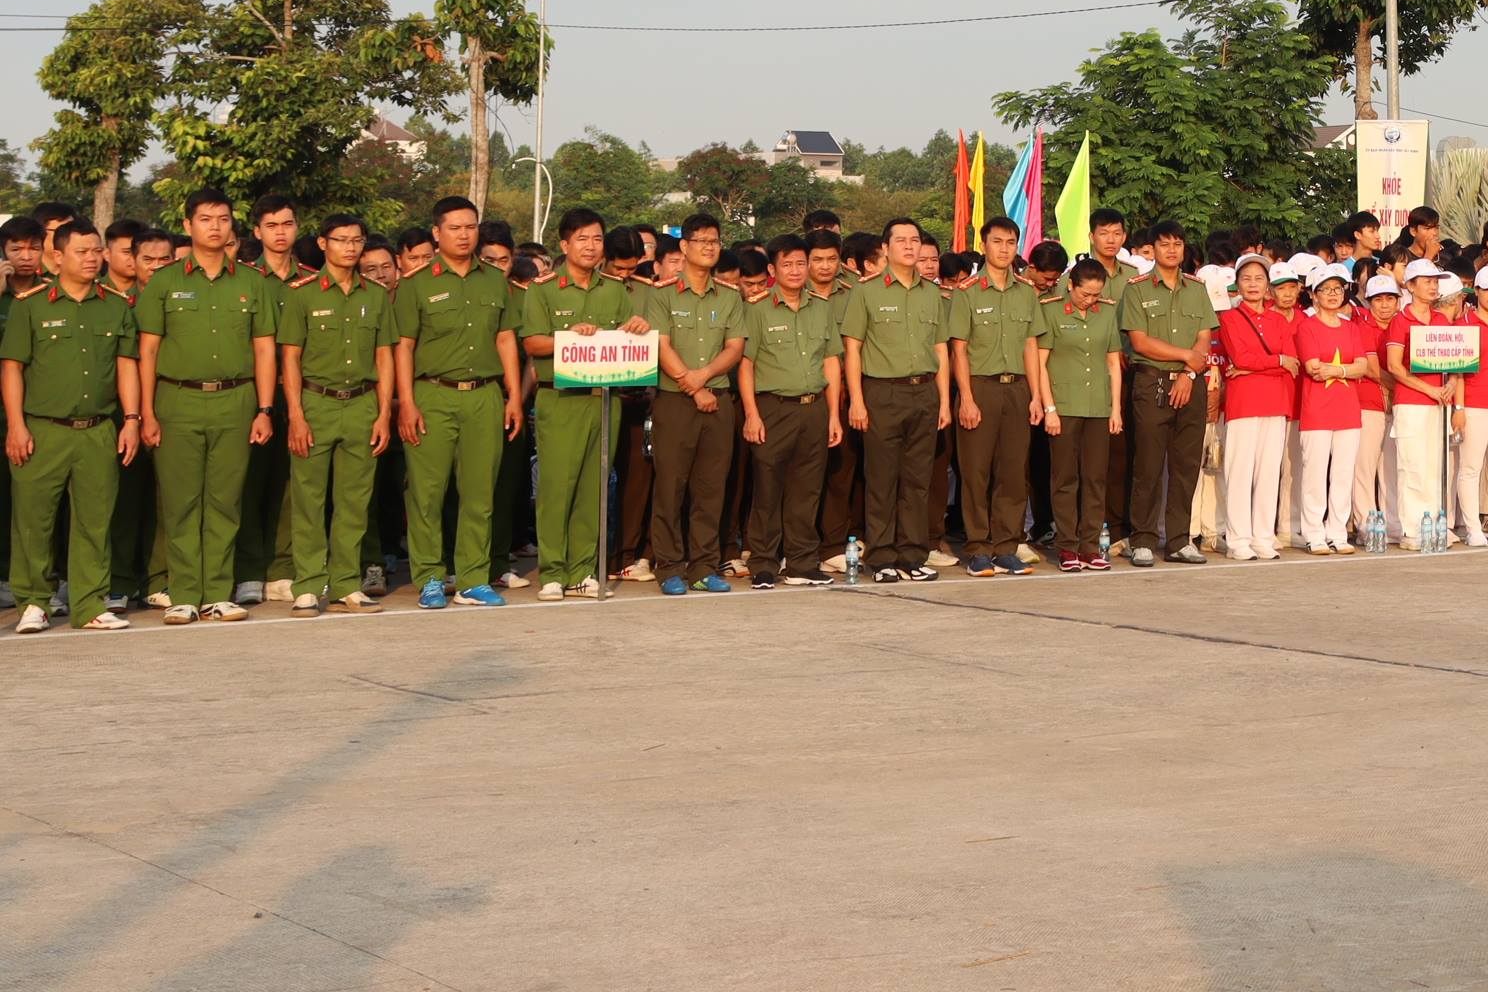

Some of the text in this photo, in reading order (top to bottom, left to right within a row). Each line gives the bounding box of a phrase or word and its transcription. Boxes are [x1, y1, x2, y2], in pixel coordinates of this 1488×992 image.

[562, 339, 649, 363] CÔNG AN TỈNH
